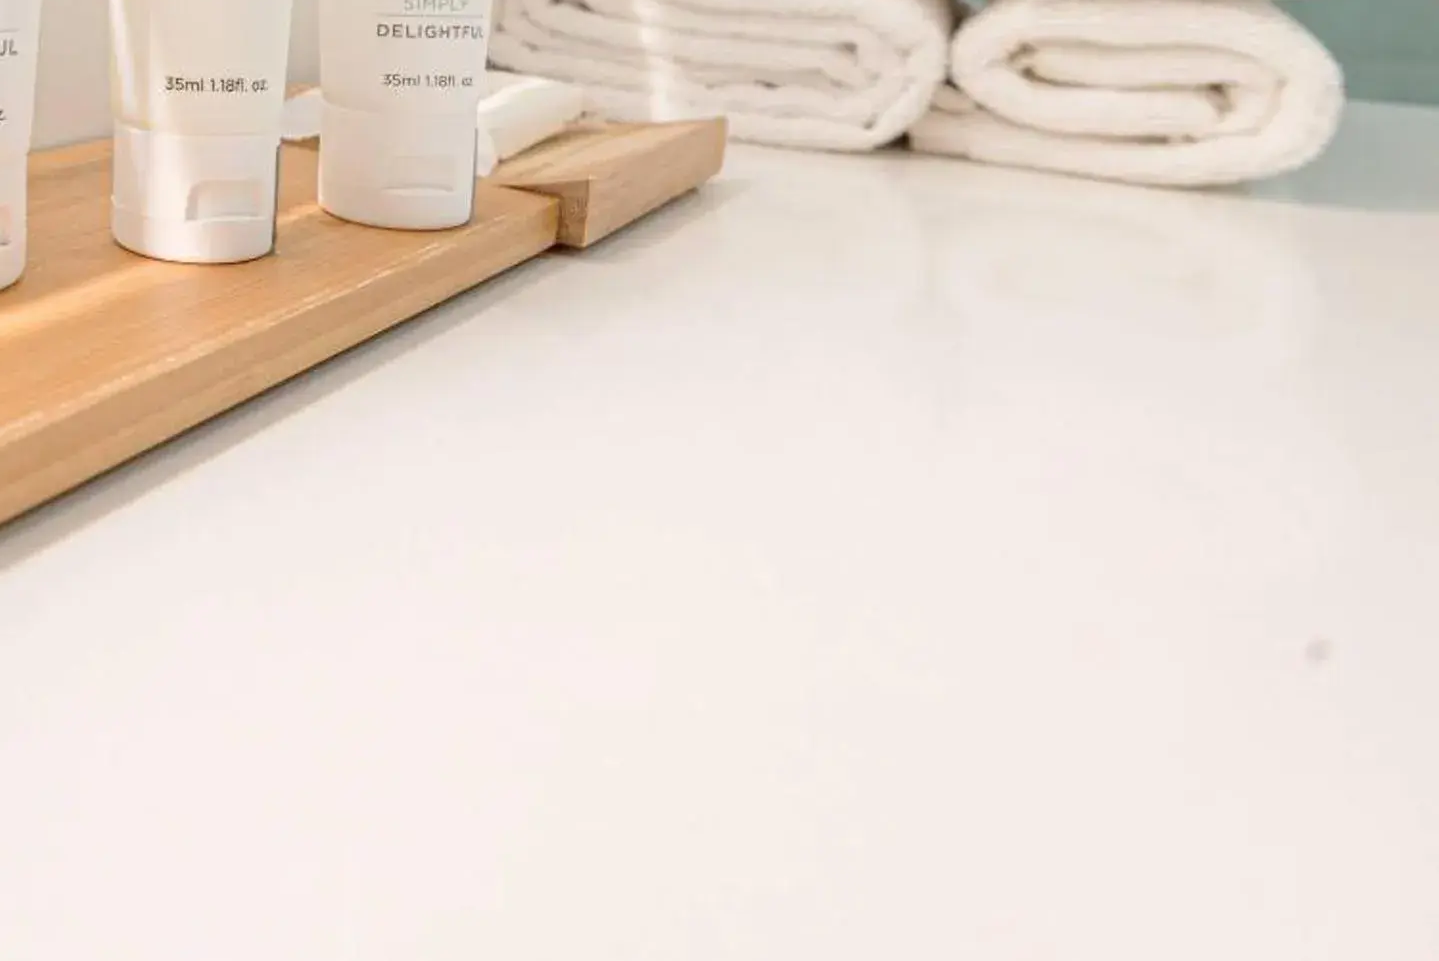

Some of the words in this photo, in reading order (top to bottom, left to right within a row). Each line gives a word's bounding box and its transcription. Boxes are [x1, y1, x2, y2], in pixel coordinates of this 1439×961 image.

[376, 23, 483, 39] DELIGHTFUL
[165, 76, 205, 93] 35ml
[380, 73, 420, 87] 35ml
